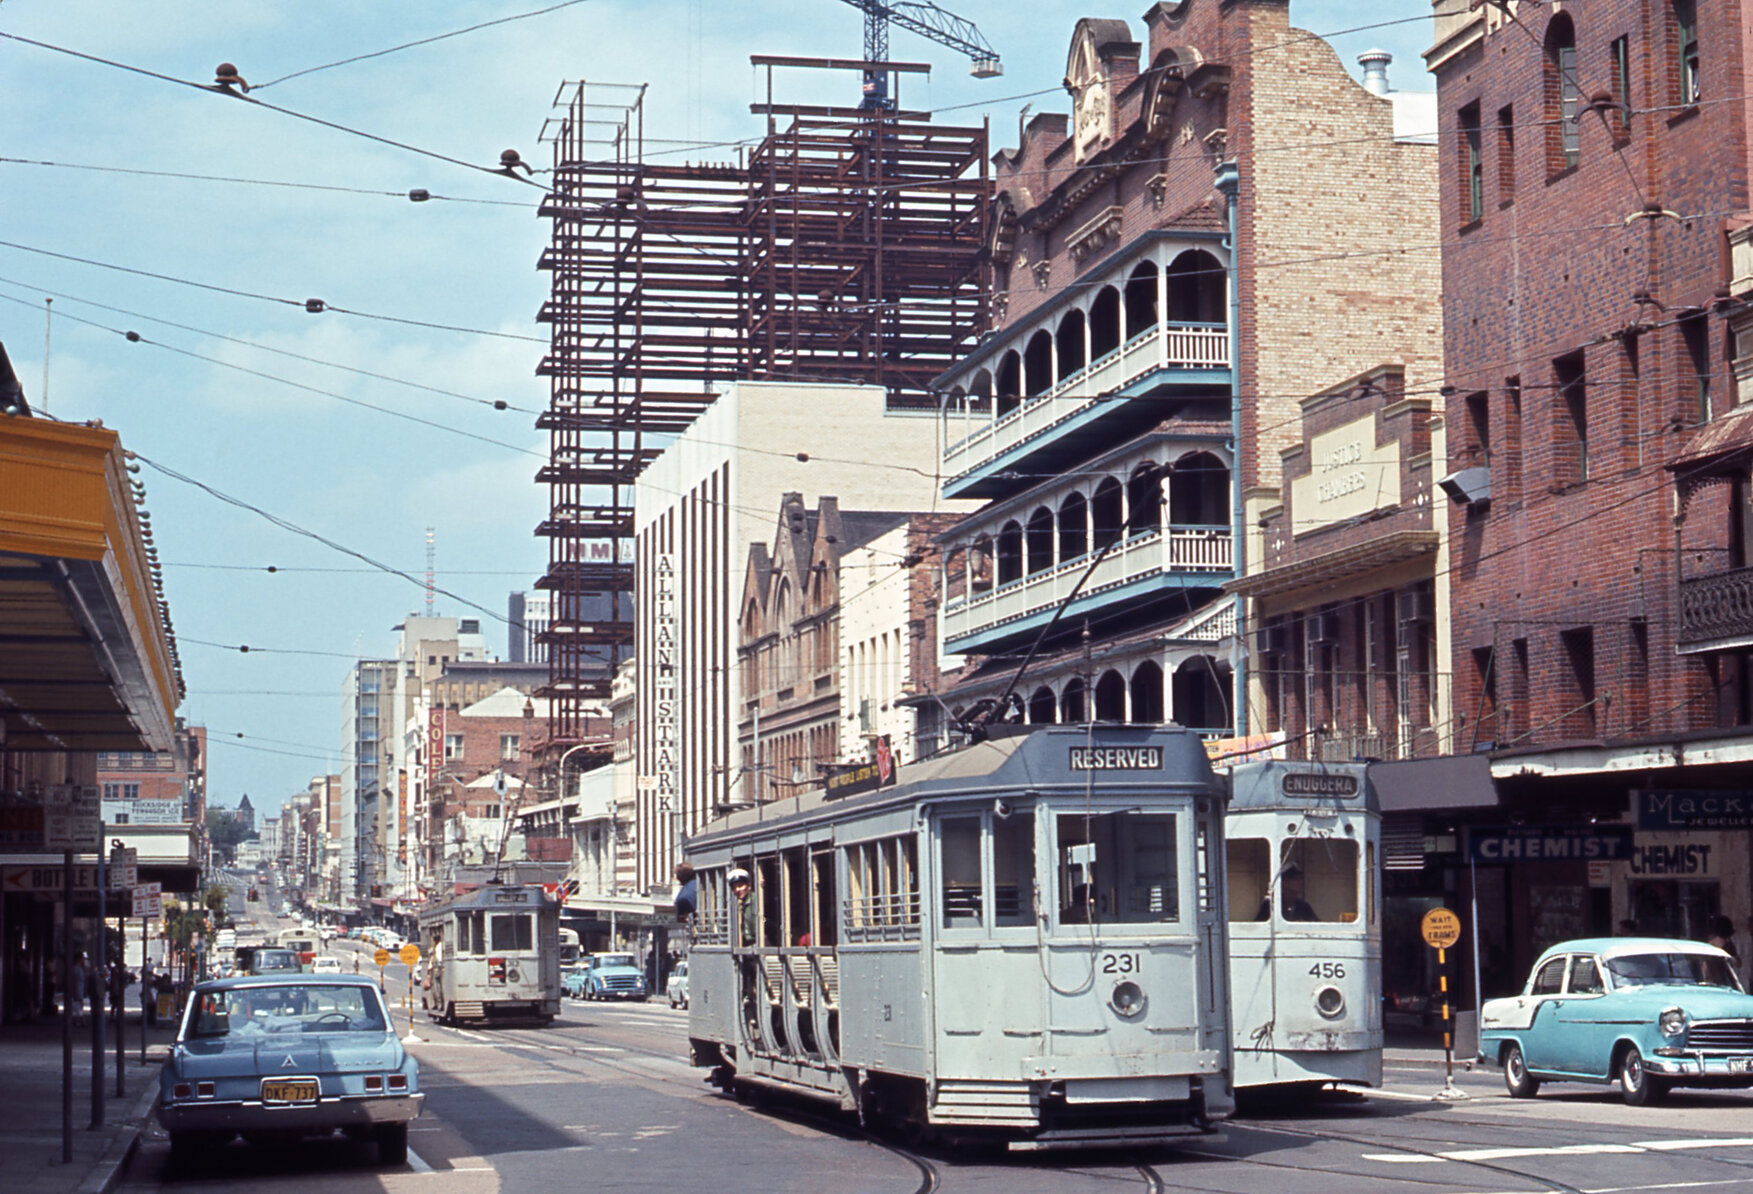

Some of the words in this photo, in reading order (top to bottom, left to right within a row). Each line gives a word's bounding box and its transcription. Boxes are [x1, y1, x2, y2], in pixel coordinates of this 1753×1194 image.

[1322, 440, 1361, 474] JUSTICE
[1318, 470, 1366, 504] CHAMBERS
[658, 556, 672, 664] ALLAN
[658, 702, 672, 811] STARK
[1071, 748, 1159, 769] RESERVED
[1480, 838, 1621, 859] CHEMIST
[1629, 844, 1712, 874] CHEMIST
[1102, 953, 1140, 974] 231
[1308, 962, 1346, 979] 456
